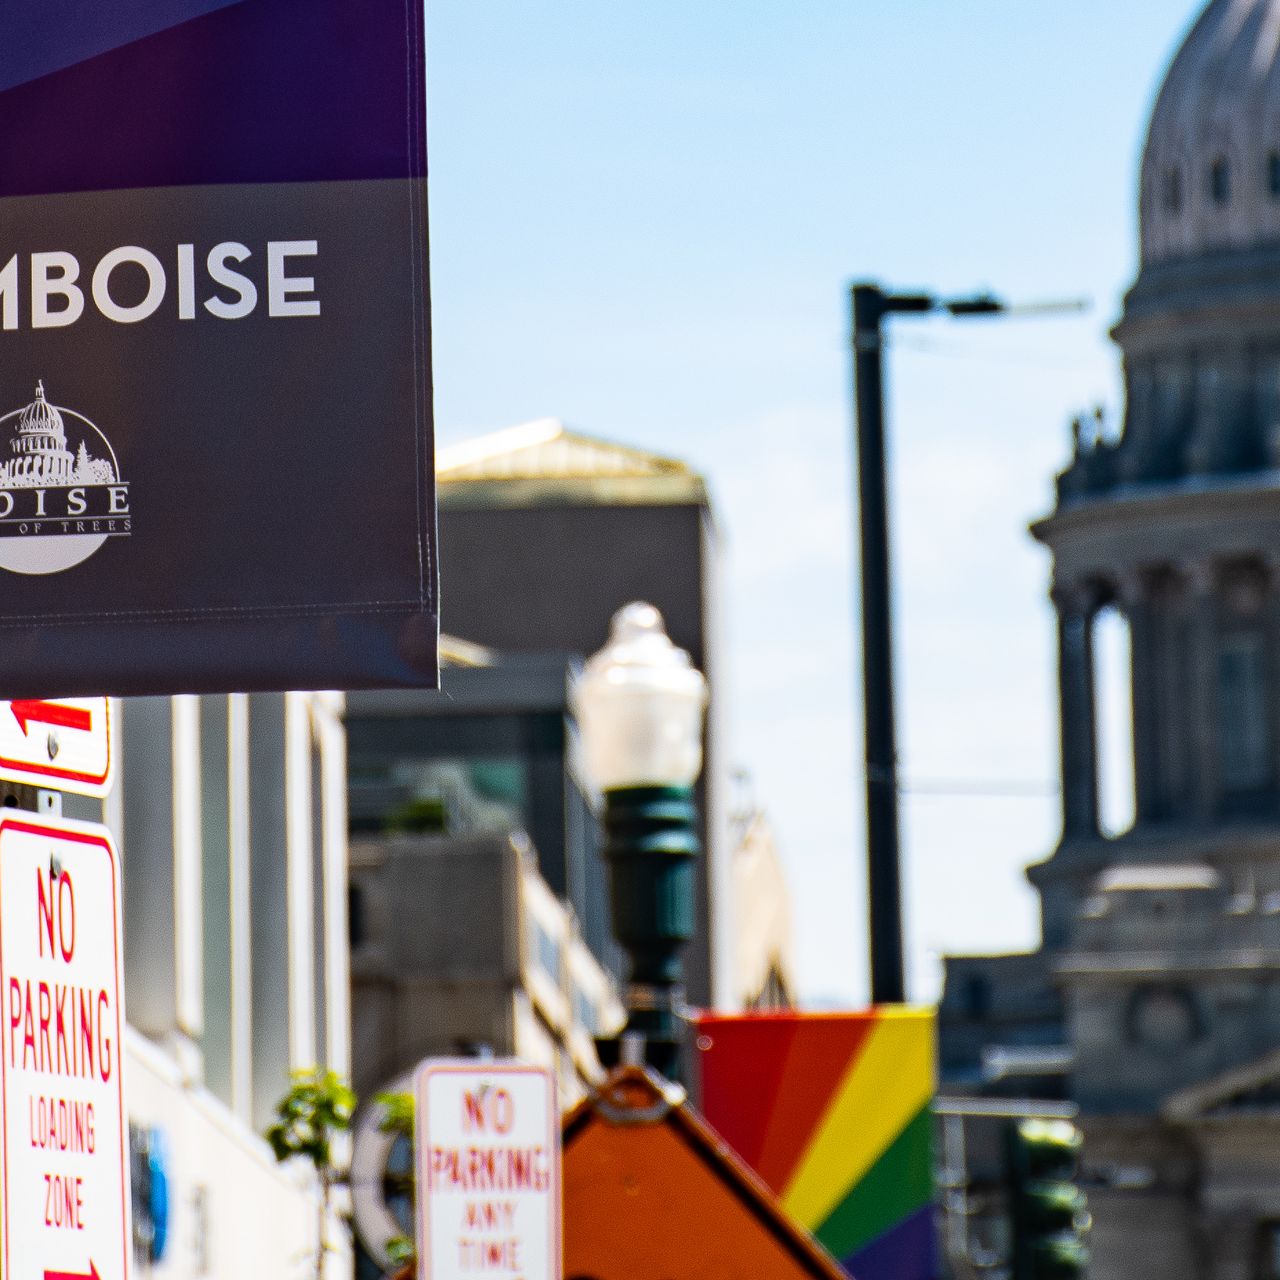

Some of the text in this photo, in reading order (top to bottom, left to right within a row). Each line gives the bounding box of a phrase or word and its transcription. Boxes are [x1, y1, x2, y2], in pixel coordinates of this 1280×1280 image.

[19, 523, 42, 535] OF
[61, 520, 132, 533] TREES
[37, 866, 75, 963] NO
[10, 977, 111, 1082] PARKING
[30, 1095, 95, 1153] LOADING
[462, 1087, 514, 1134] NO
[427, 1144, 550, 1193] PARKING
[44, 1174, 84, 1229] ZONE
